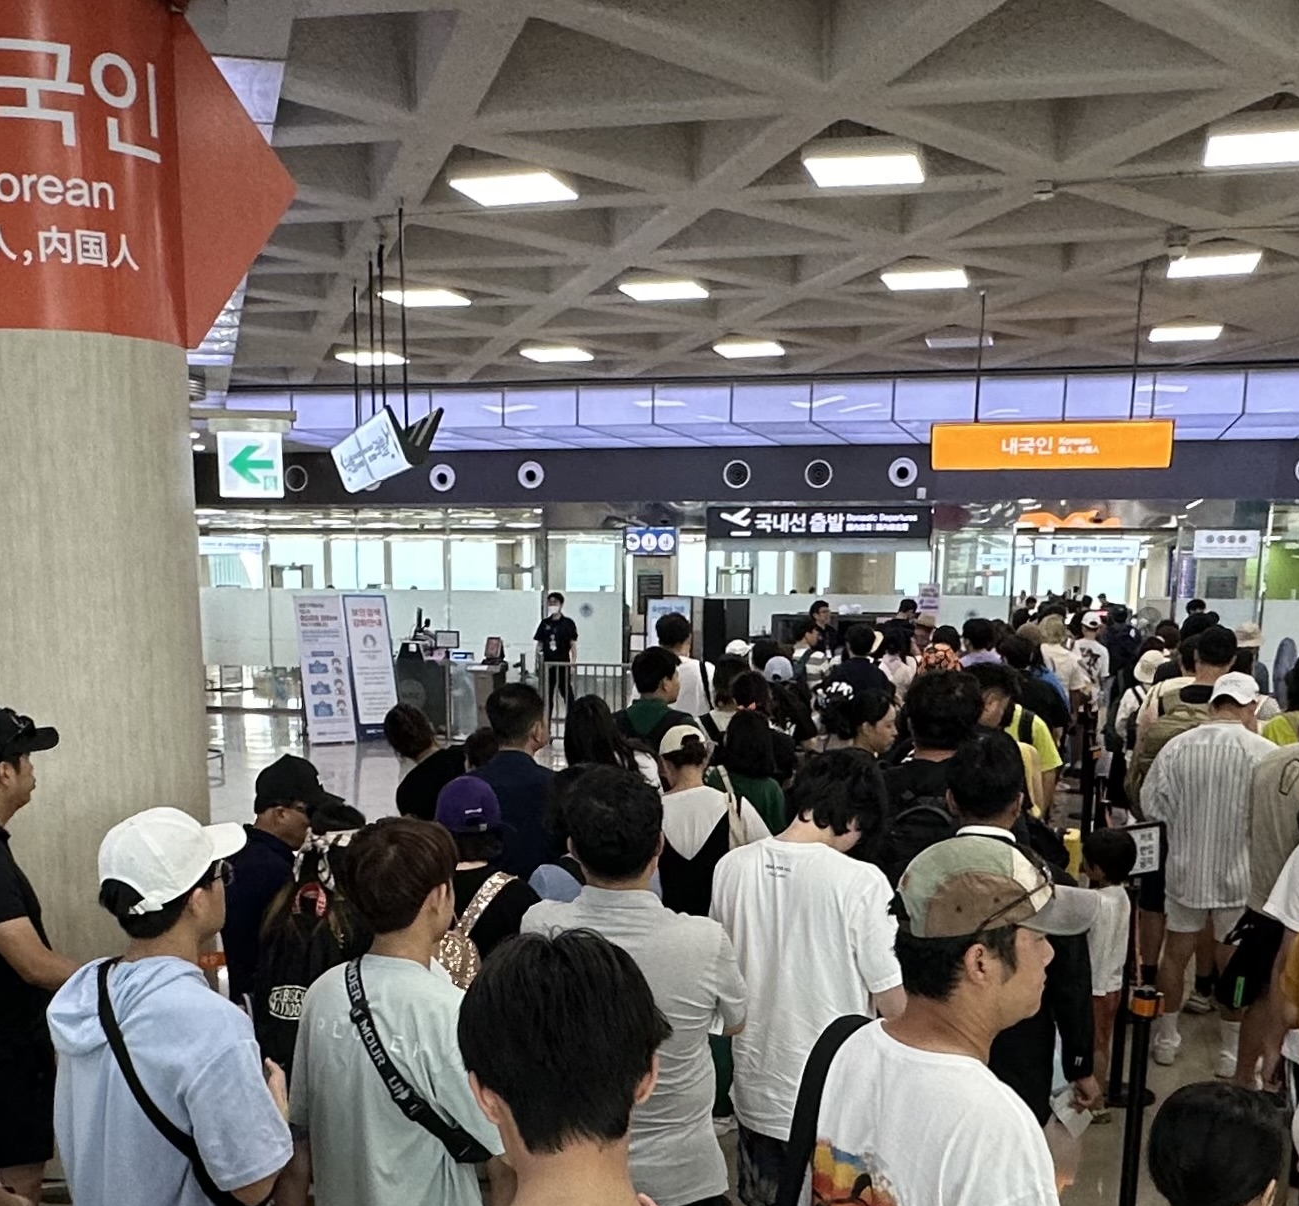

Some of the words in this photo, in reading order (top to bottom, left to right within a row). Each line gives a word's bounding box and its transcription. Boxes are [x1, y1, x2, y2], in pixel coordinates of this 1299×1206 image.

[1002, 436, 1053, 455] 내국인
[754, 513, 806, 533] 국내선
[809, 513, 845, 532] 출발
